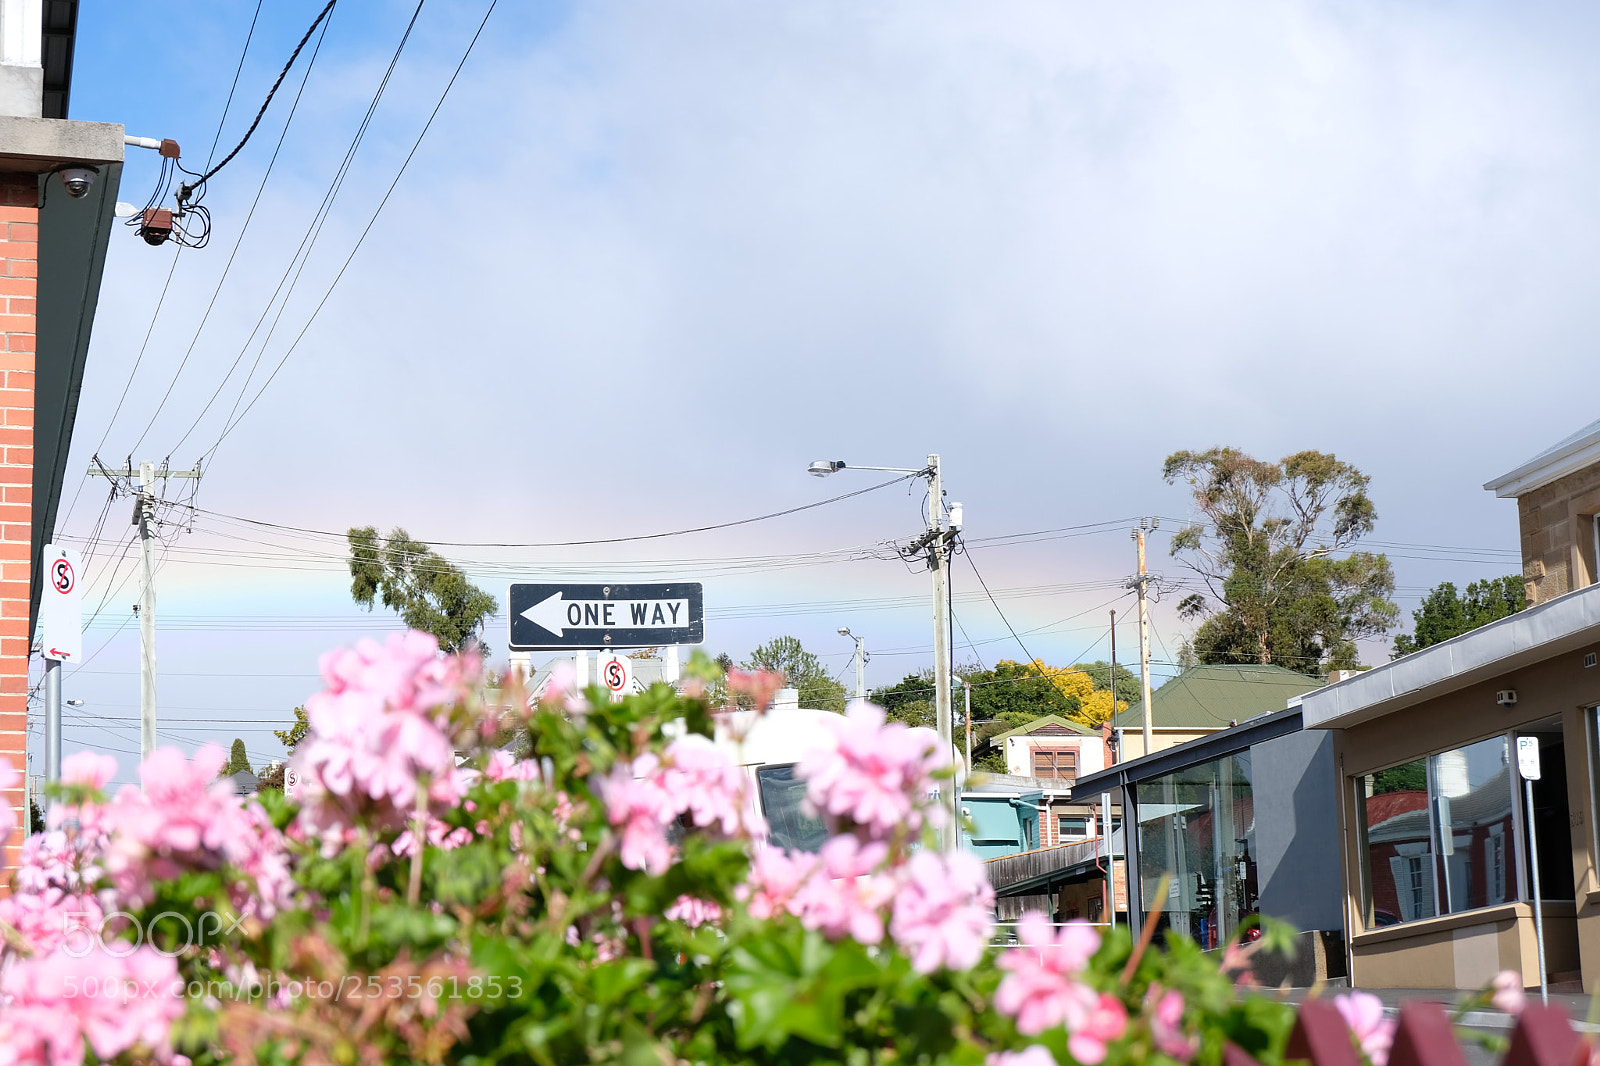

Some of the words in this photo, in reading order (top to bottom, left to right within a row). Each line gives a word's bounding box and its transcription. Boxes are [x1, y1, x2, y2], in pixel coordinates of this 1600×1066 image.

[567, 603, 616, 626] ONE
[630, 602, 681, 625] WAY
[1520, 740, 1528, 750] P
